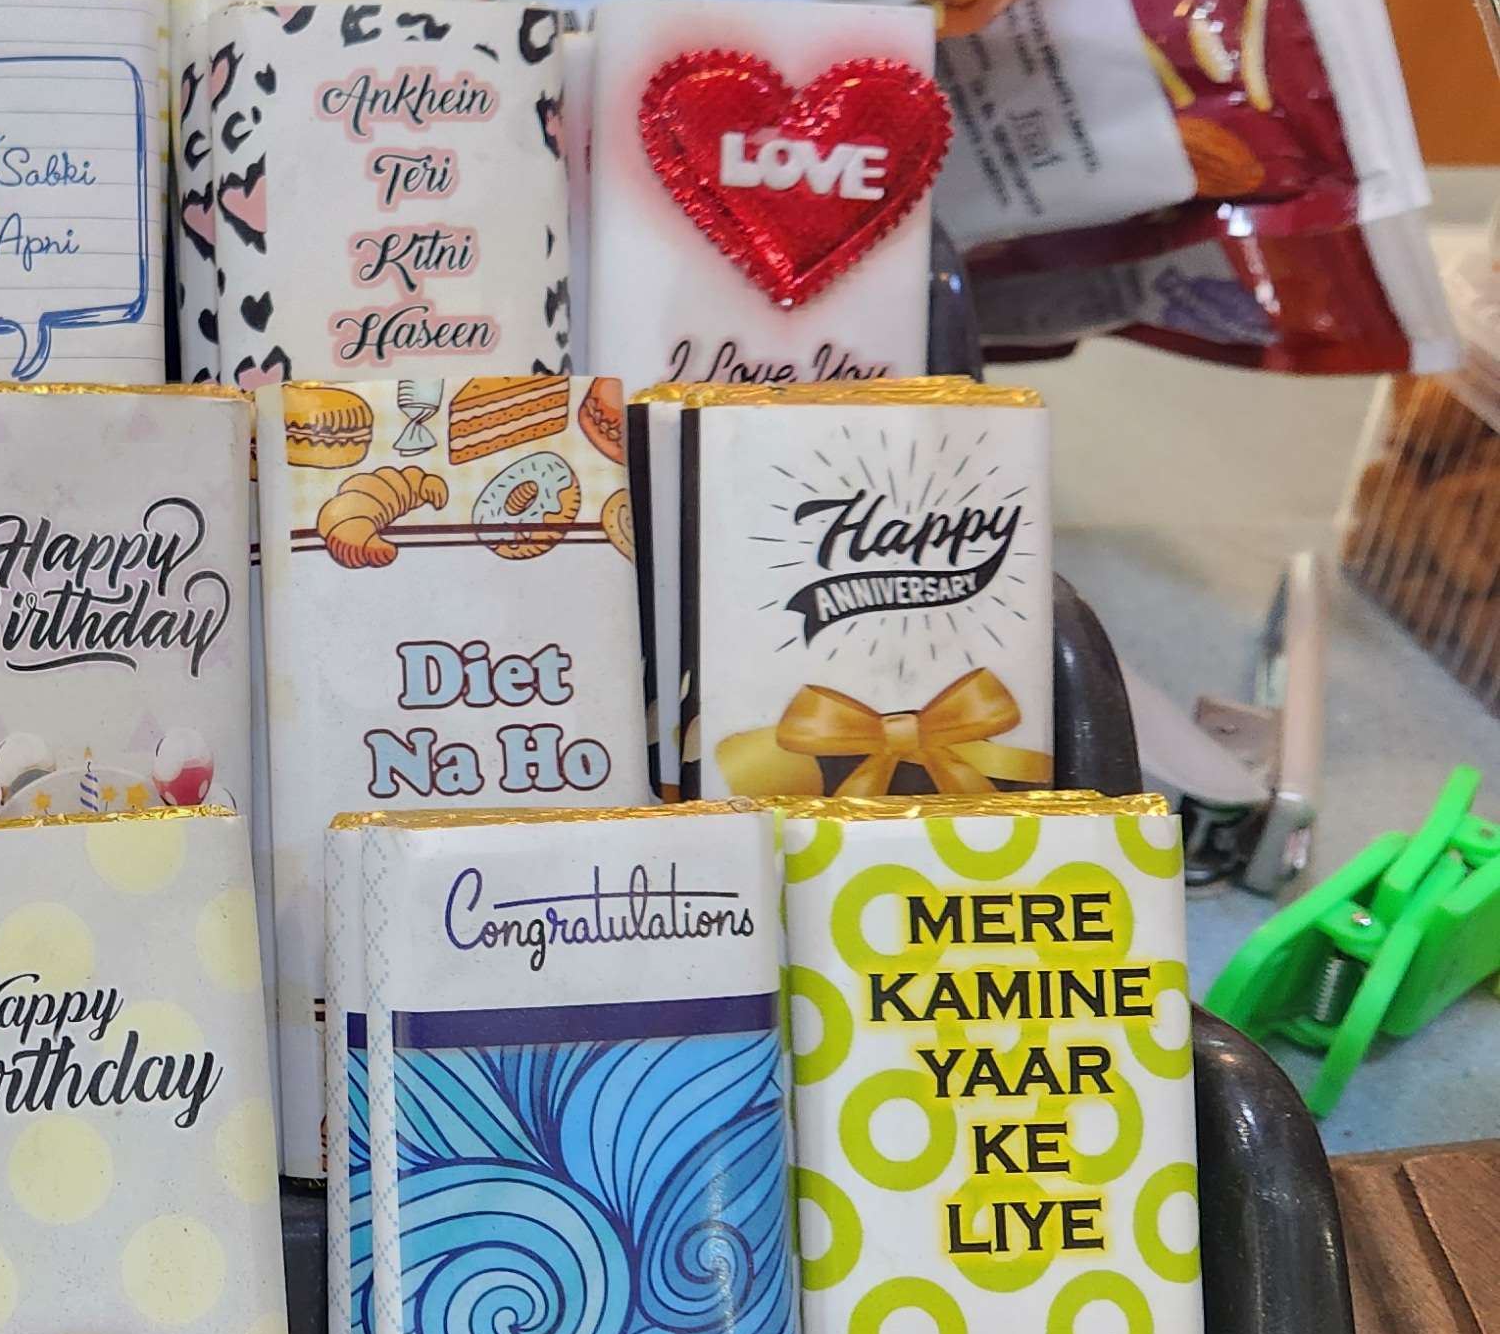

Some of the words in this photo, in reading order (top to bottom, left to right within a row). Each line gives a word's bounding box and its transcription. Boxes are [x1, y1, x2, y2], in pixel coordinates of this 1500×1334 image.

[321, 72, 496, 137] Ankhein
[371, 153, 454, 206] Teri
[718, 130, 889, 201] LOVE
[354, 228, 475, 293] Kitni
[334, 304, 496, 361] Haseen
[662, 339, 692, 383] I
[694, 340, 798, 384] Love
[793, 487, 1024, 571] Happy
[813, 571, 980, 623] ANNIVERSARY
[395, 639, 575, 711] Diet
[363, 726, 486, 799] Na
[495, 722, 612, 794] Ho
[444, 861, 756, 973] Congratulations
[905, 890, 1115, 946] MERE
[867, 965, 1156, 1024] KAMINE
[915, 1044, 1117, 1099] YAAR
[970, 1121, 1072, 1176] KE
[945, 1196, 1107, 1255] LIYE
